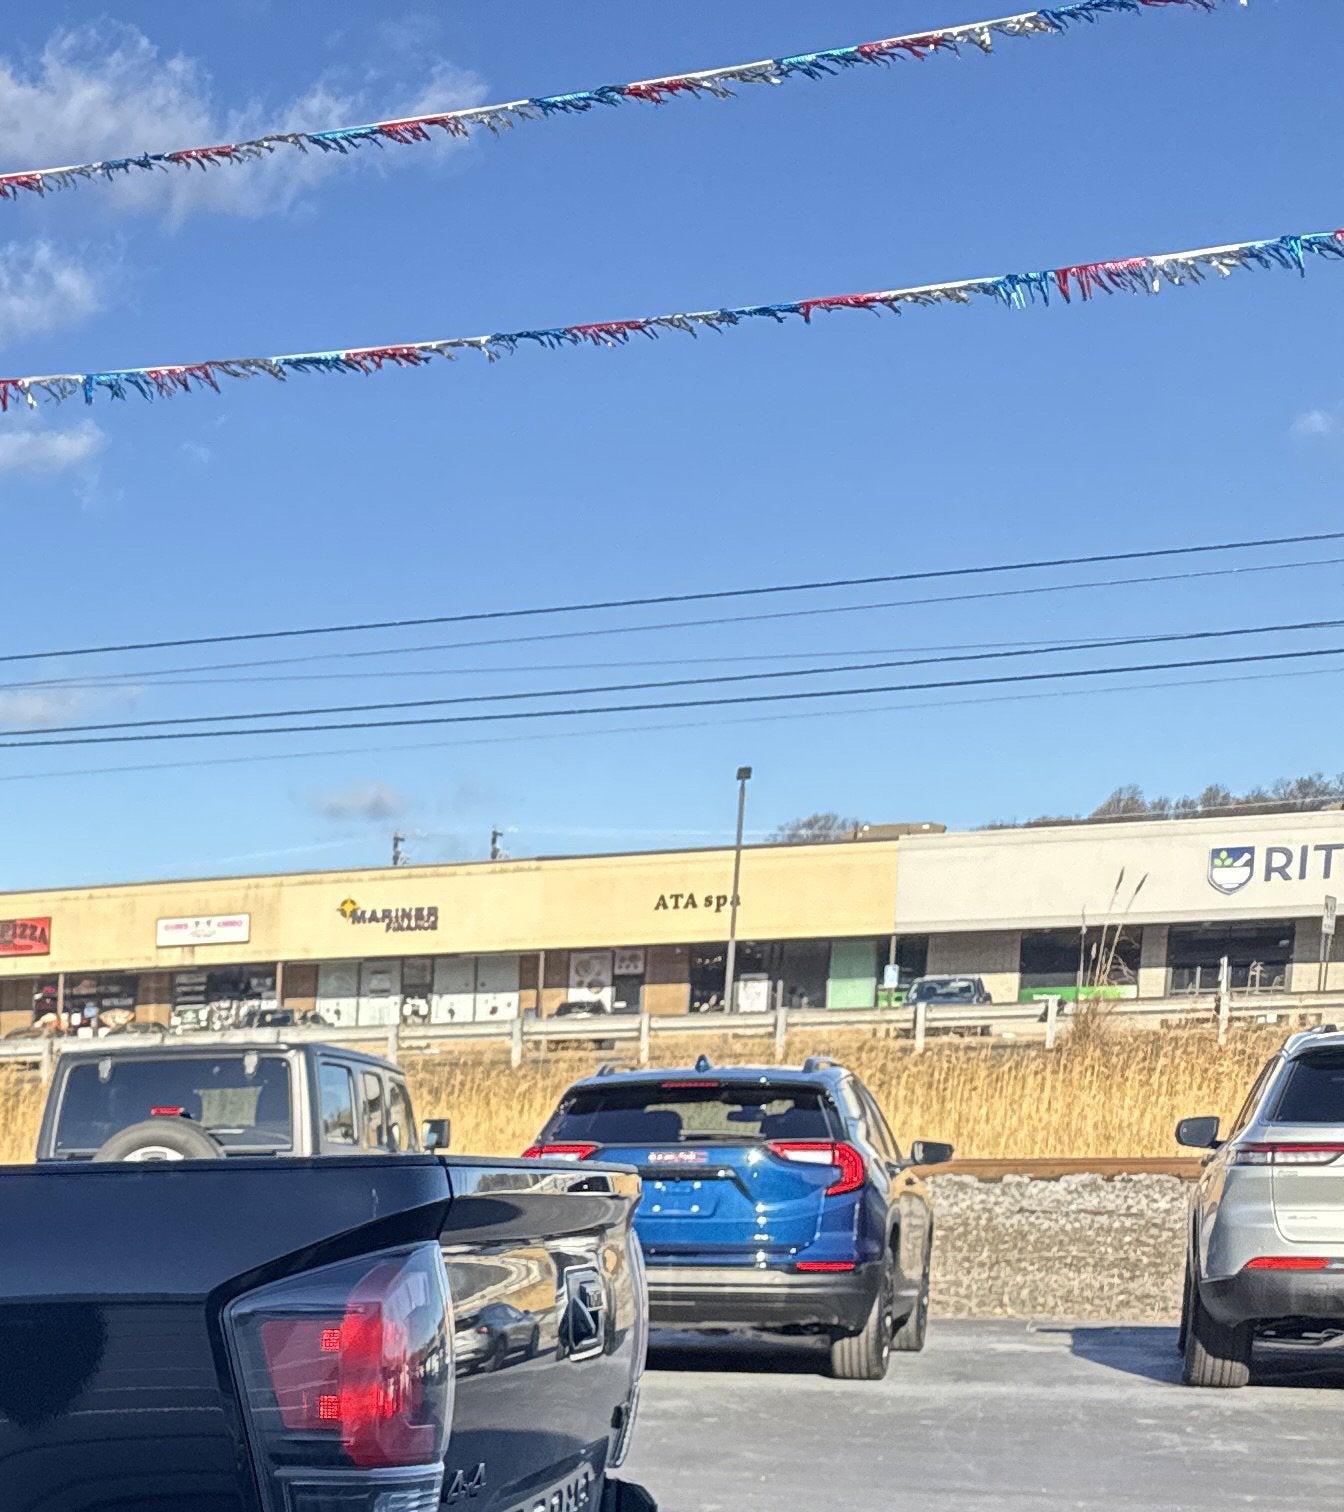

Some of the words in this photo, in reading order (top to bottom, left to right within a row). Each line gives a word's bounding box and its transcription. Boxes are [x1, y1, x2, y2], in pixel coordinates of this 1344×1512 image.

[1263, 843, 1344, 882] RIT
[654, 892, 698, 911] ATA
[350, 906, 439, 925] MARINER
